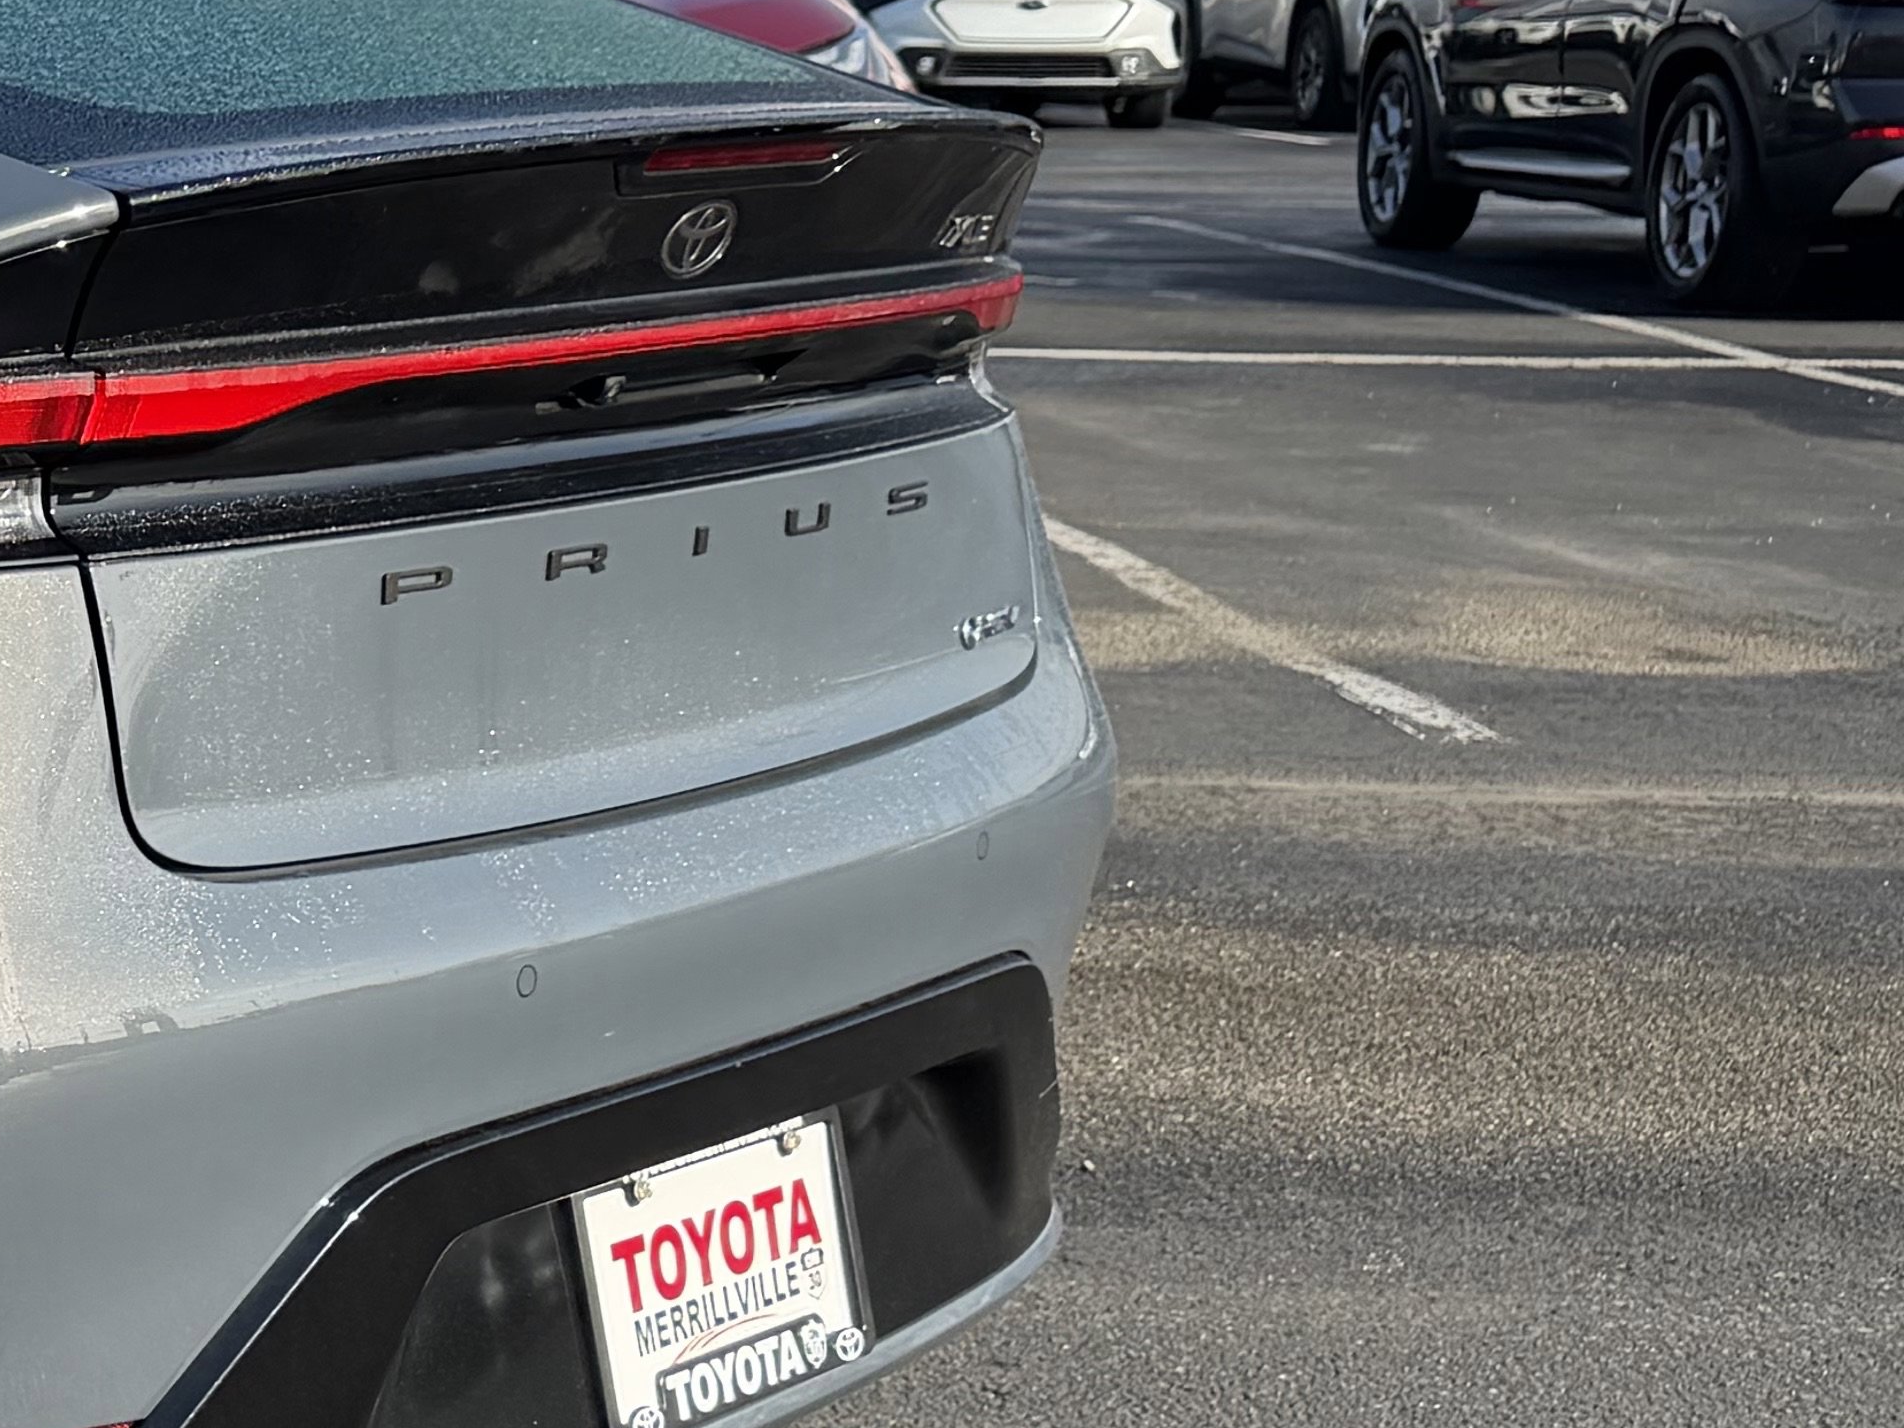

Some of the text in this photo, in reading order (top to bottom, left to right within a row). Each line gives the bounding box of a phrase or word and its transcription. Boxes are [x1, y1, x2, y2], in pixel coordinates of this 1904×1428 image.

[379, 480, 930, 607] PRIUS
[610, 1179, 821, 1313] TOYOTA
[633, 1262, 801, 1358] MERRILLVILLE
[666, 1331, 805, 1421] TOYOTA
